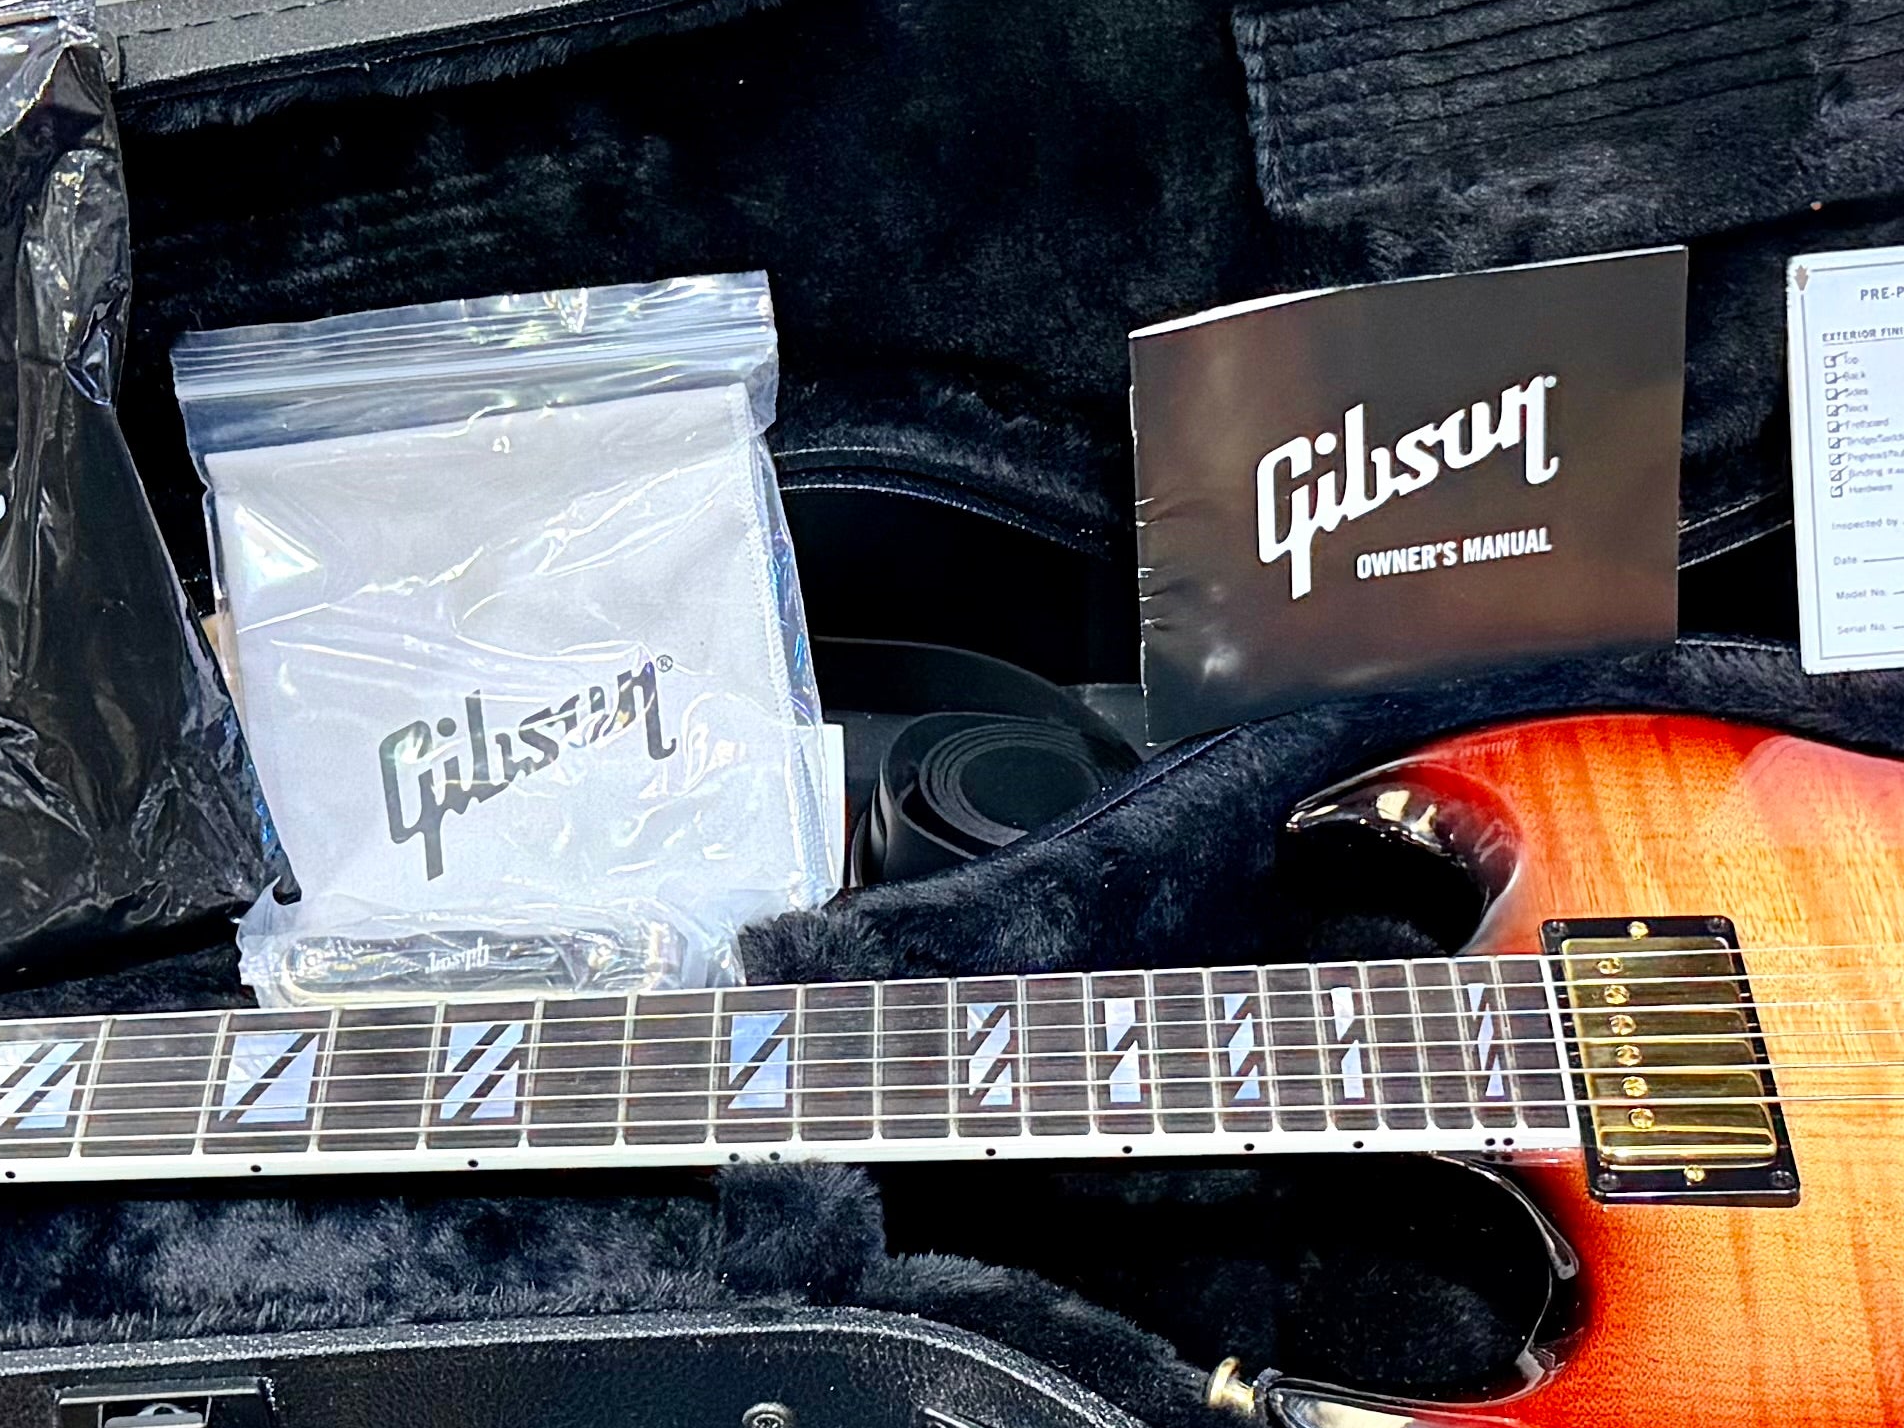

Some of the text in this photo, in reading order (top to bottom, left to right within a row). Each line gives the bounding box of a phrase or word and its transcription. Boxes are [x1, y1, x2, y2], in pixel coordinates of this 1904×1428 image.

[1822, 329, 1876, 343] EXTERIOR
[1256, 373, 1560, 600] Gibson
[1356, 526, 1553, 580] OWNER'S MANUAL
[378, 656, 678, 882] Gibson
